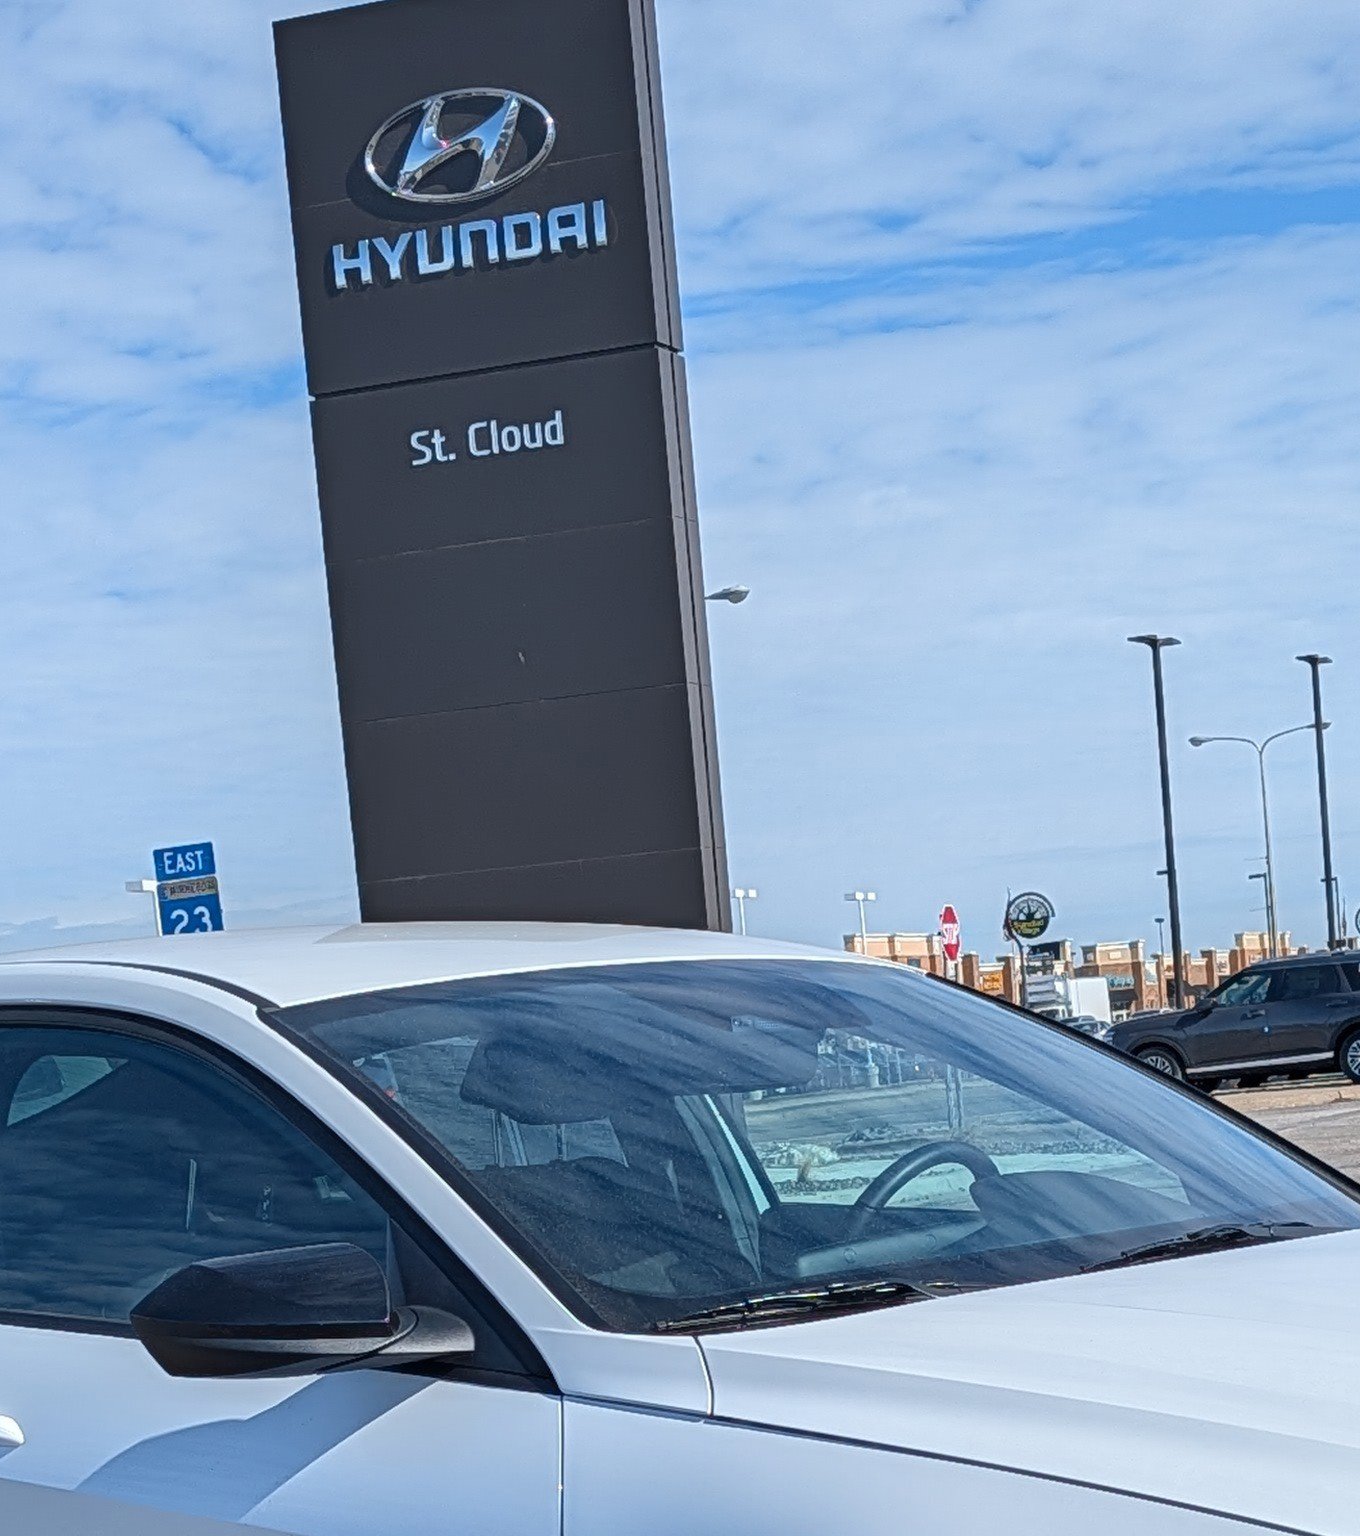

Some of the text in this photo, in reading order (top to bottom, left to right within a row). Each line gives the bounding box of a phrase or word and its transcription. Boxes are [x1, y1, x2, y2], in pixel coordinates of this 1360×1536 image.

[332, 199, 608, 290] HYUNDAI
[410, 410, 565, 466] St. Cloud
[163, 850, 204, 875] EAST
[170, 905, 214, 935] 23
